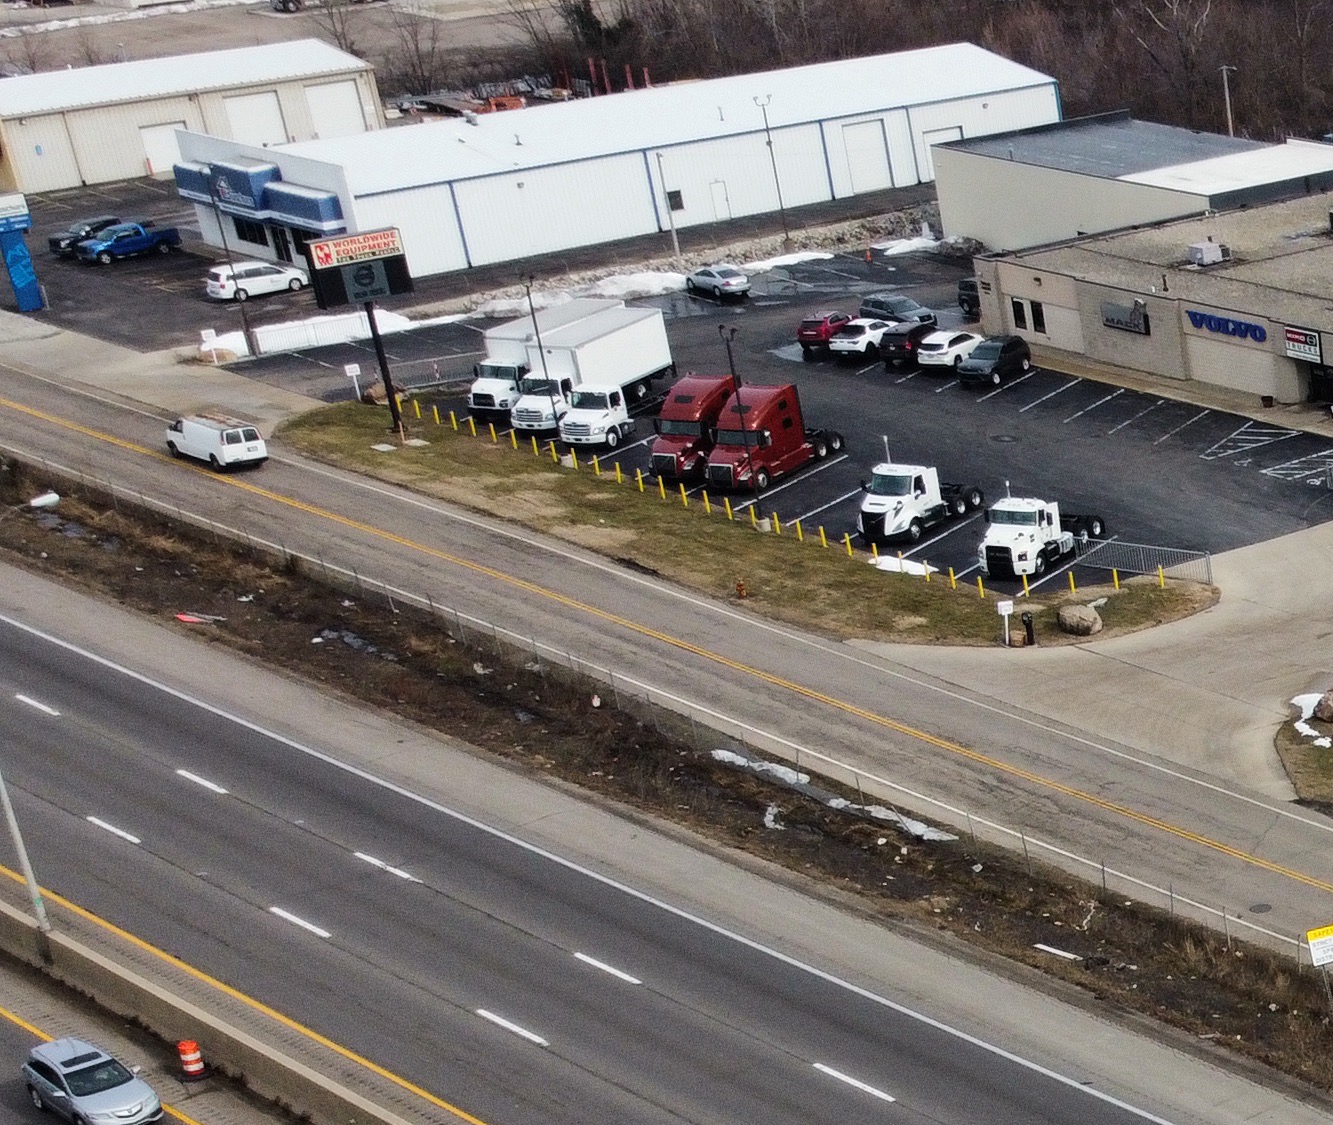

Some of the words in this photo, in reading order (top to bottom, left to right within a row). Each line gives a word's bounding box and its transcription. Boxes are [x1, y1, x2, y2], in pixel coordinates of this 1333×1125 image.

[332, 231, 396, 249] WORLDWIDE
[336, 240, 397, 257] EQUIPMENT
[1105, 316, 1143, 331] MACK
[1185, 310, 1267, 343] VOLVO
[1286, 341, 1318, 354] TRUCKS
